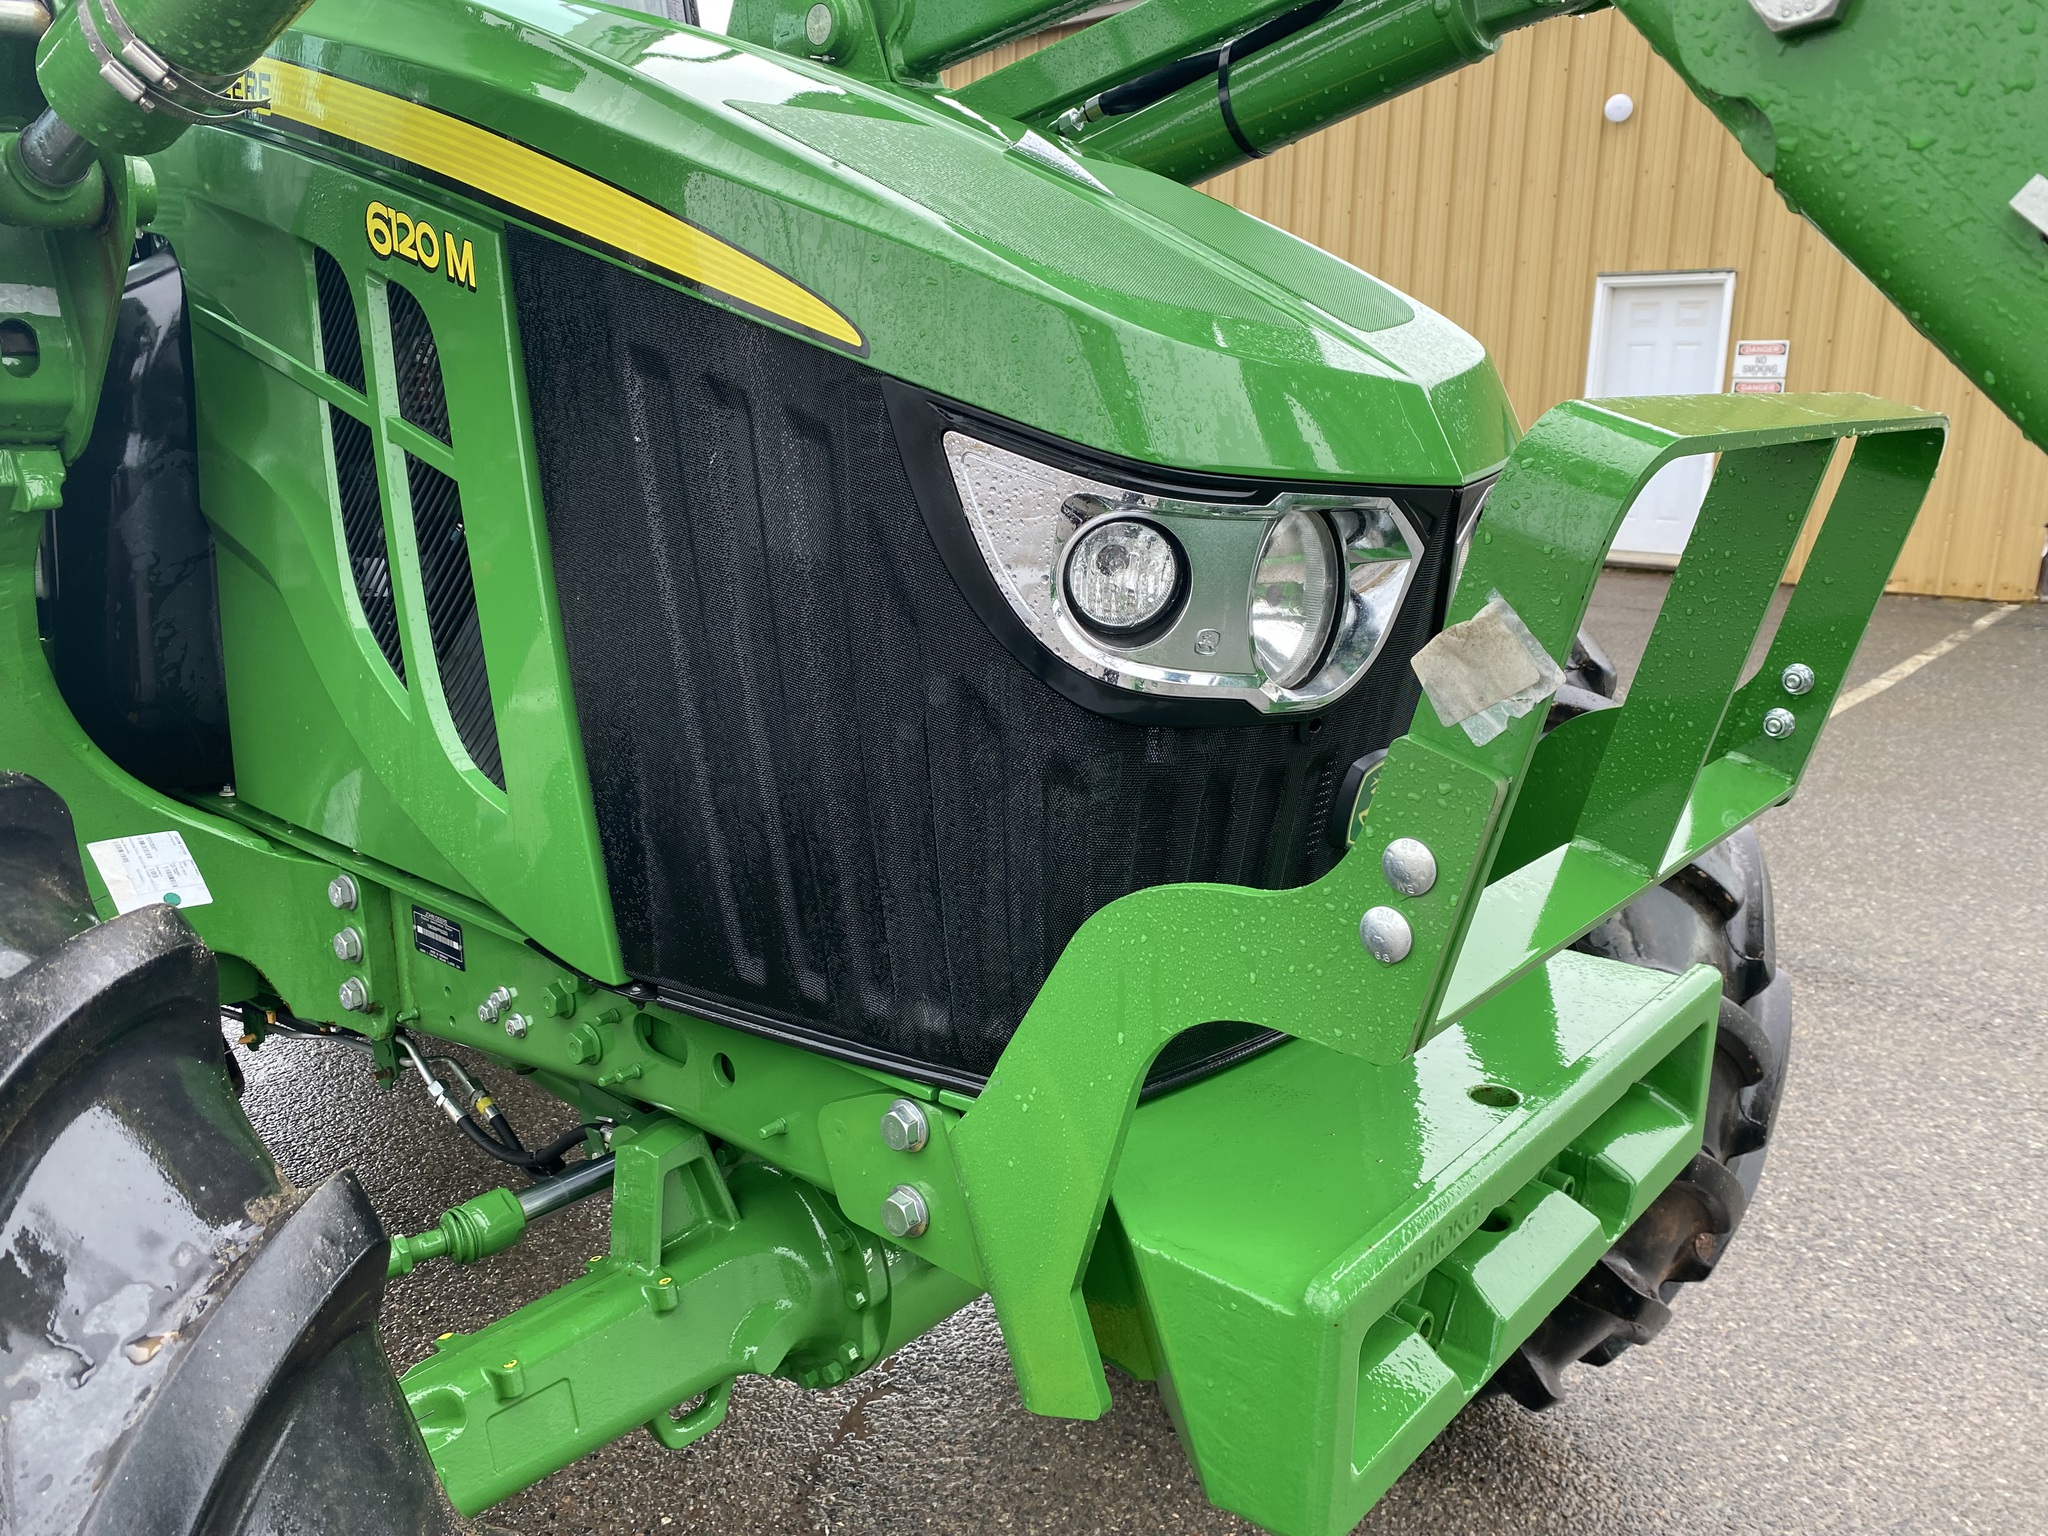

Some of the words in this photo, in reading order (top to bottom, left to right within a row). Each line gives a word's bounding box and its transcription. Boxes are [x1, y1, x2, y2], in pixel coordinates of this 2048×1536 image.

[364, 200, 440, 273] 6120
[443, 230, 477, 293] M
[1745, 345, 1780, 353] DANGER
[1755, 356, 1767, 364] NO
[1742, 364, 1778, 373] SMOKING
[1740, 383, 1776, 391] DANGER
